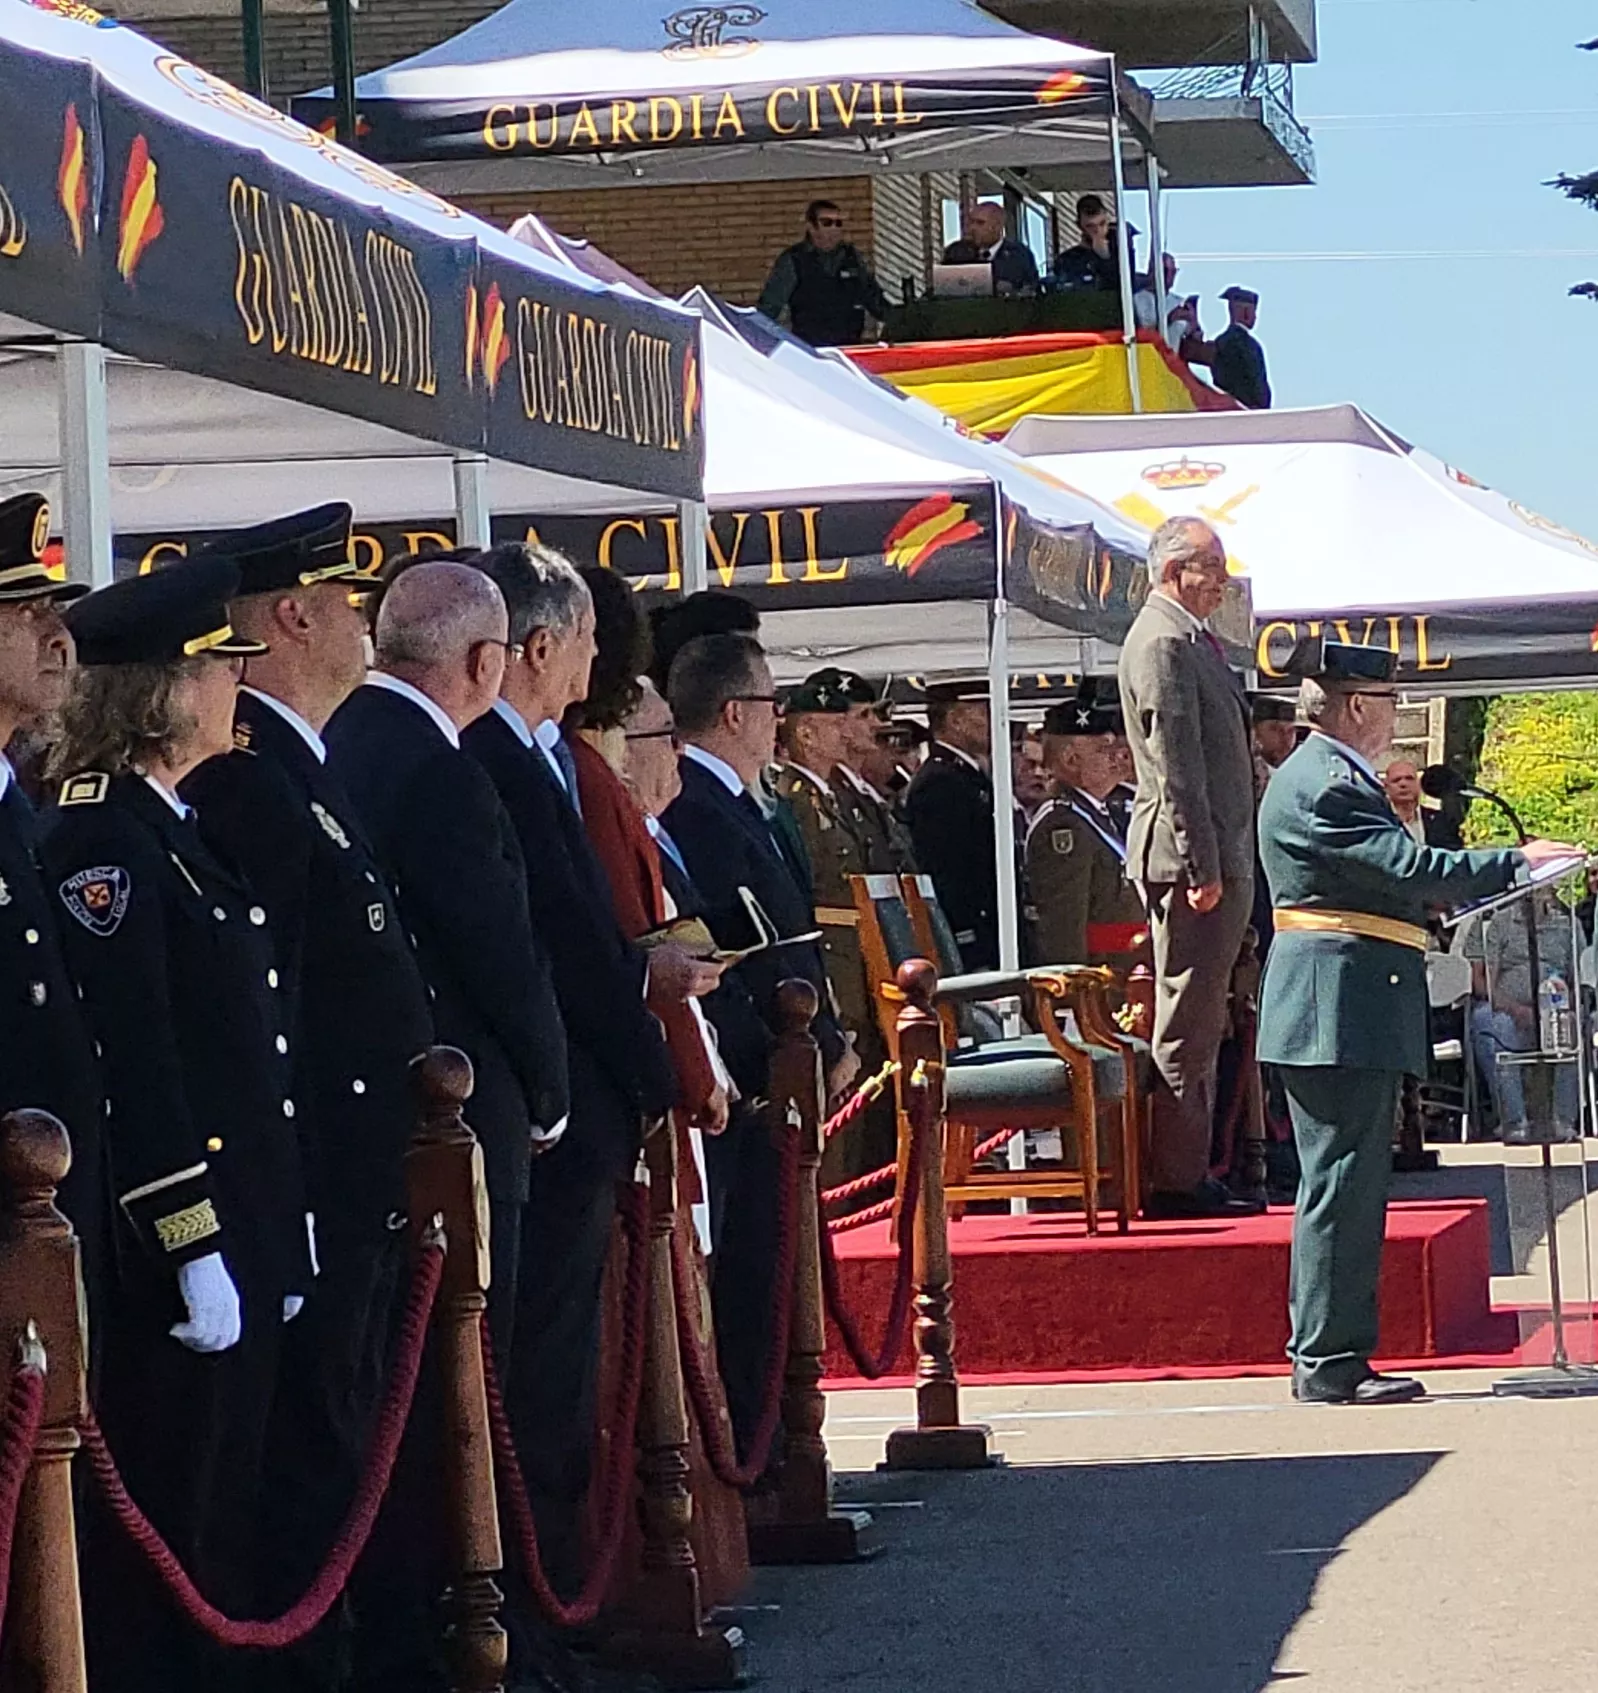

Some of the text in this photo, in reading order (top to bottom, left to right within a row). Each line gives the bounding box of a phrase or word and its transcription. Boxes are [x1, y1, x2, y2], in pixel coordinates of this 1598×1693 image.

[483, 81, 923, 150] GUARDIA CIVIL
[230, 176, 437, 396] GUARDIA CIVIL
[518, 297, 681, 450] GUARDIA CIVIL
[598, 507, 849, 592] CIVIL
